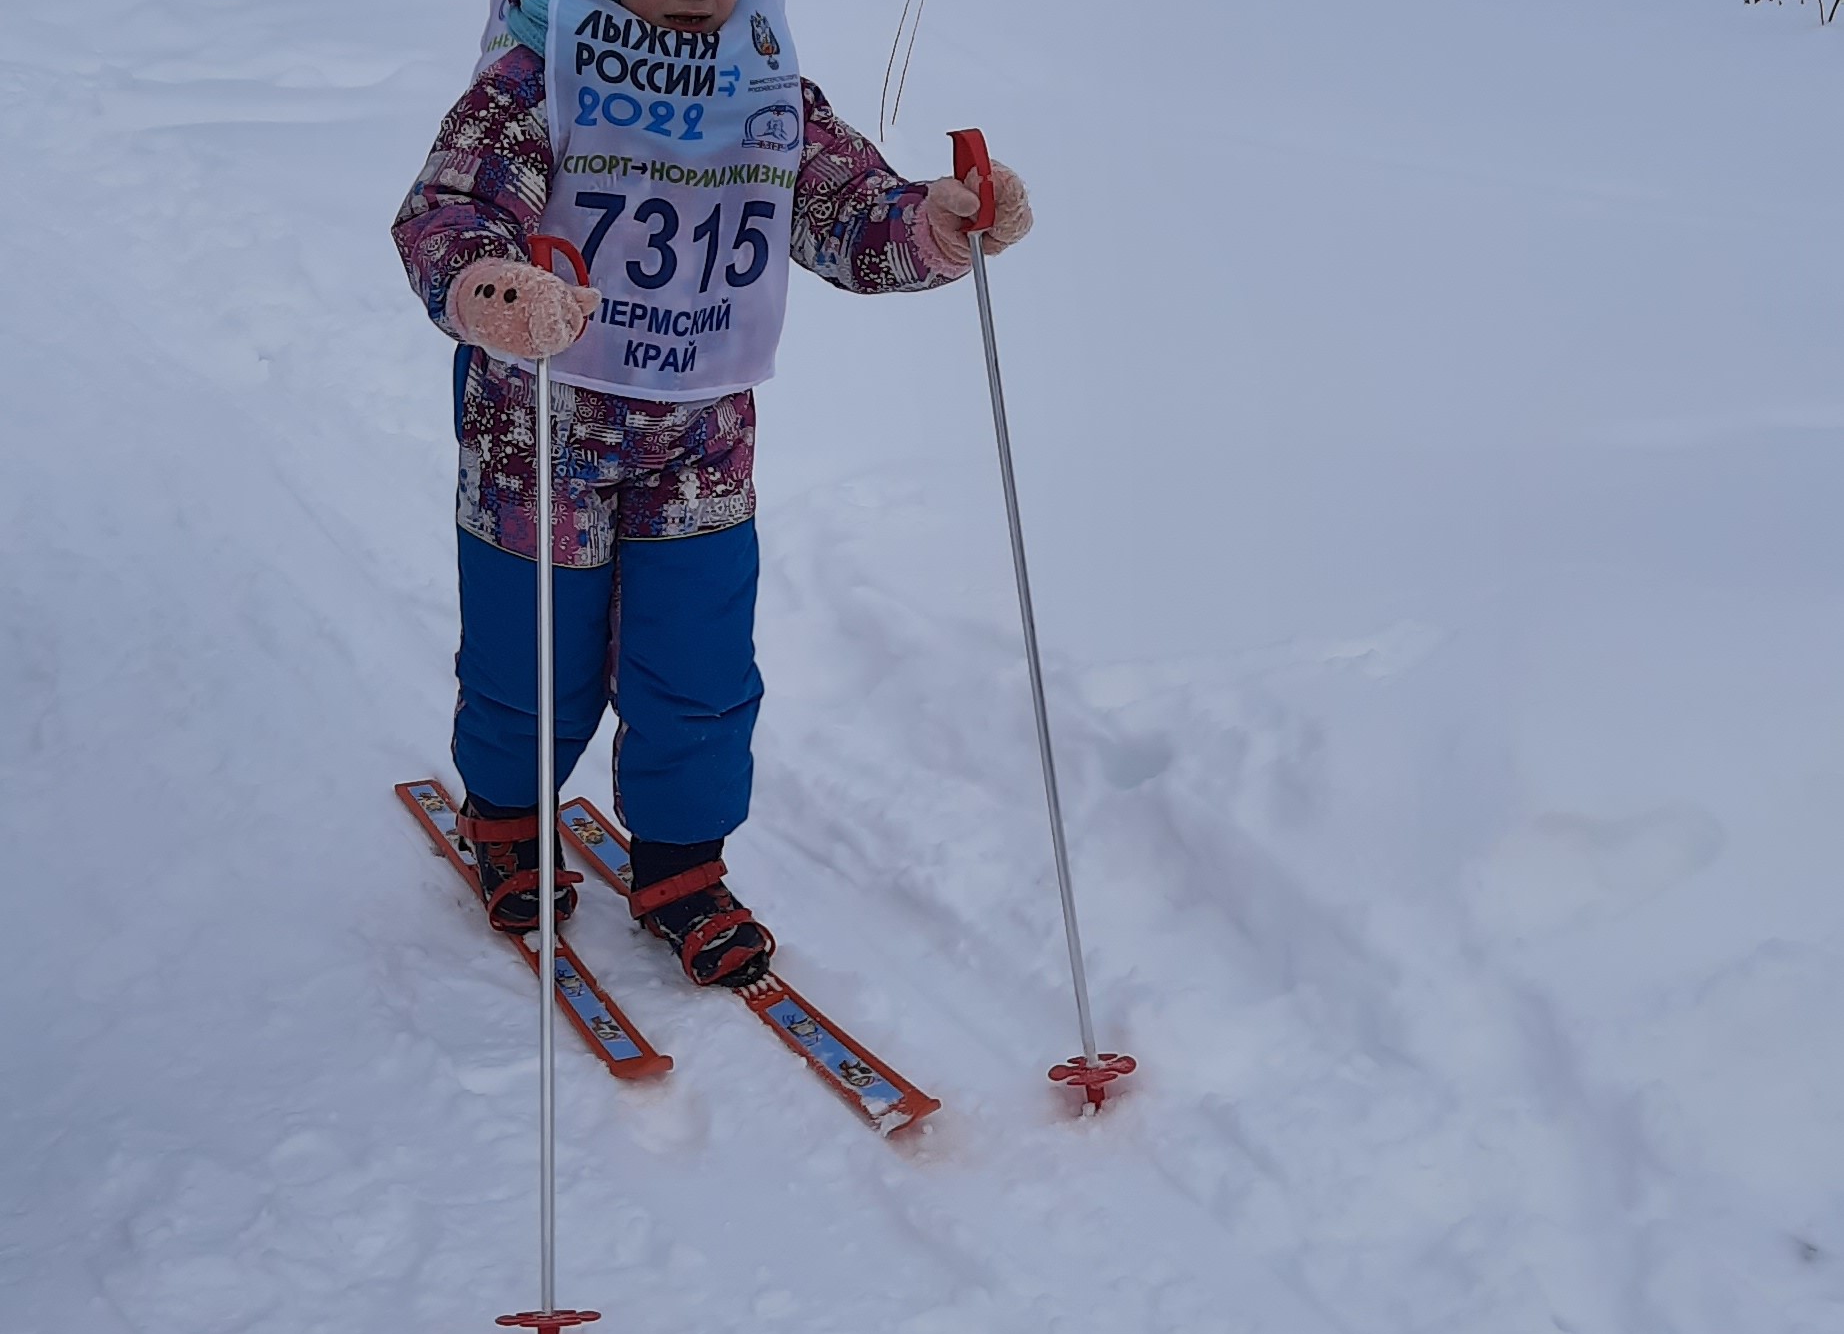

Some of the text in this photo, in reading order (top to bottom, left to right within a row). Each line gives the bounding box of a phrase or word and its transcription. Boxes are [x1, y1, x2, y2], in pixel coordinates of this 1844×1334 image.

[575, 9, 721, 60] ЛЫЖНЯ
[575, 41, 716, 97] РОССИИ
[575, 86, 705, 141] 2022
[562, 155, 633, 176] СПОРТ
[575, 191, 776, 293] 7315
[624, 339, 698, 373] КРАЙ
